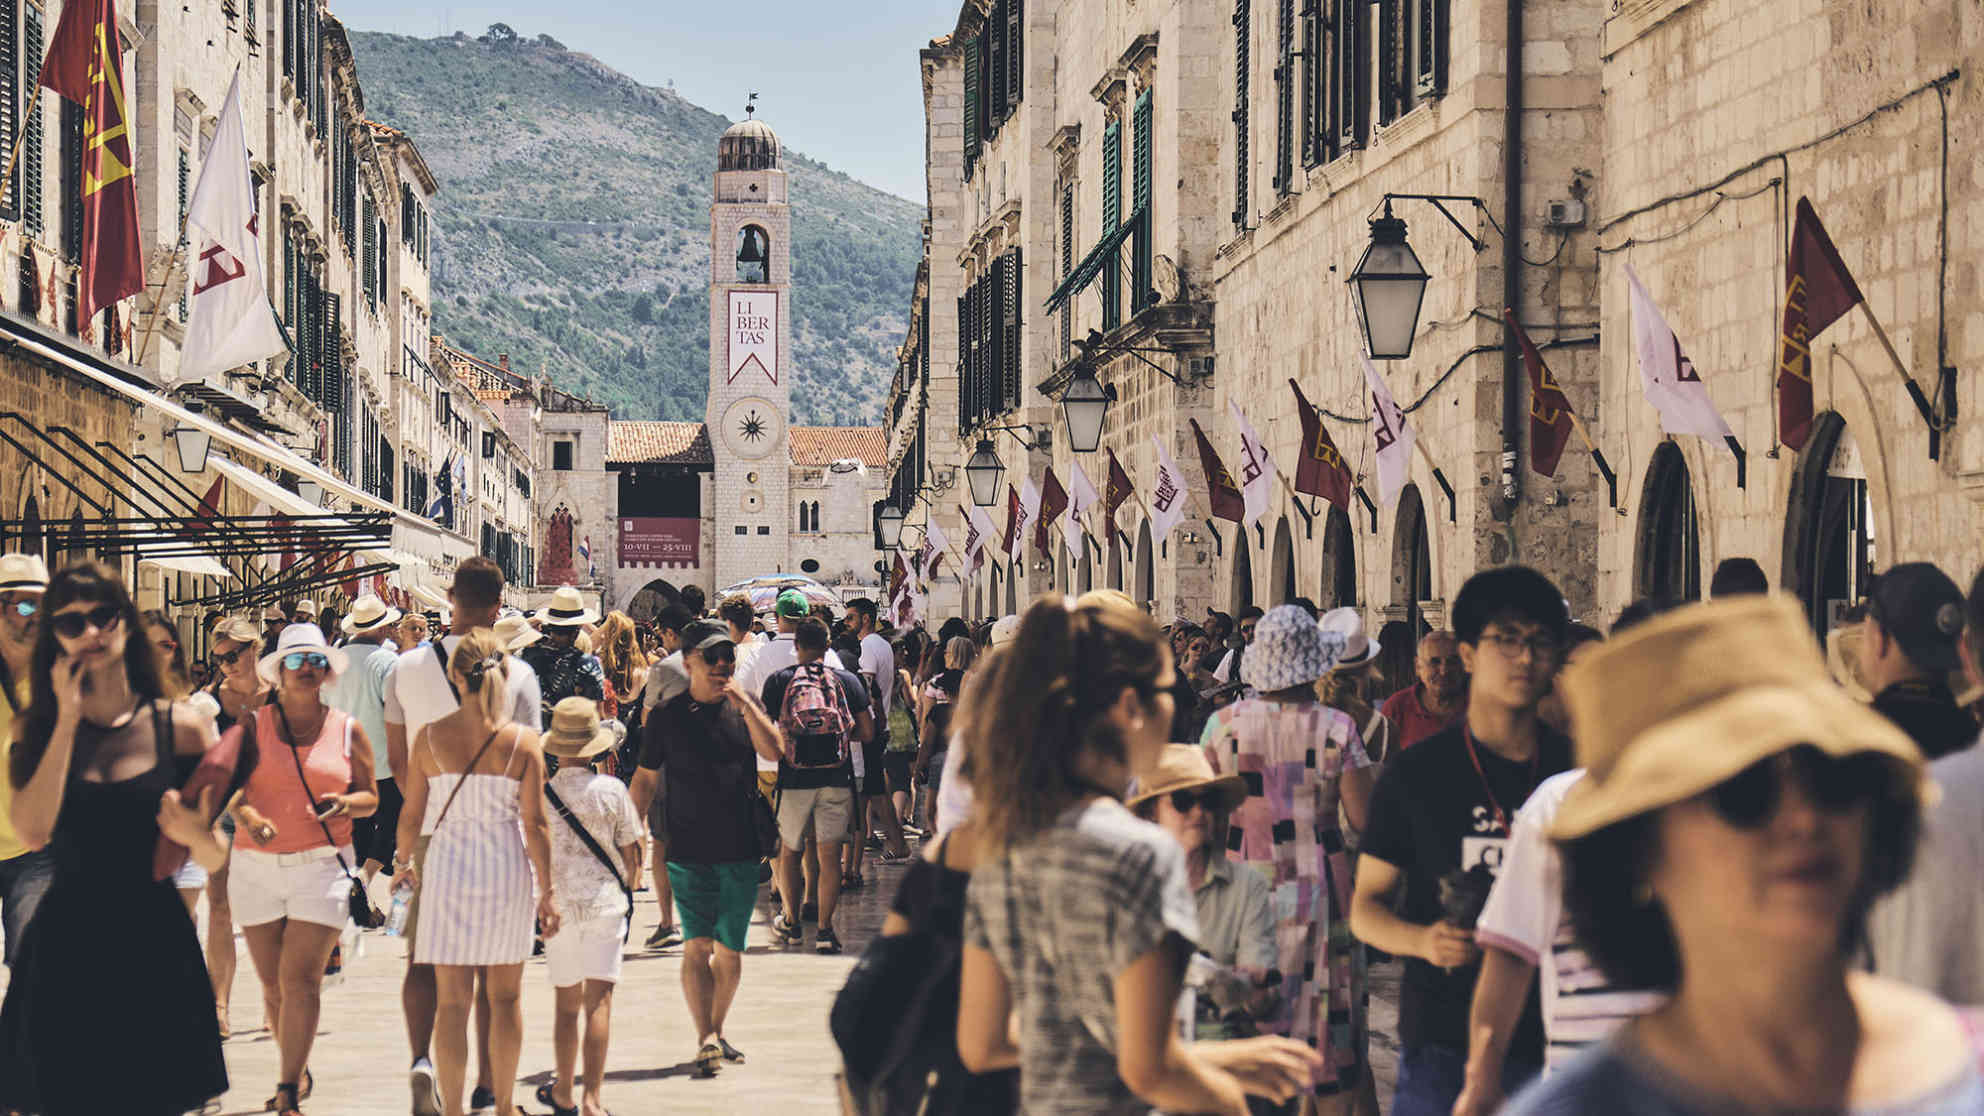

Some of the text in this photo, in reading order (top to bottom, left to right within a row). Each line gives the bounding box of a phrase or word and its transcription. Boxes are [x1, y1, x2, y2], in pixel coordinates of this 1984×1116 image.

[737, 301, 752, 314] LI
[737, 316, 769, 330] BER
[736, 331, 765, 344] TAS
